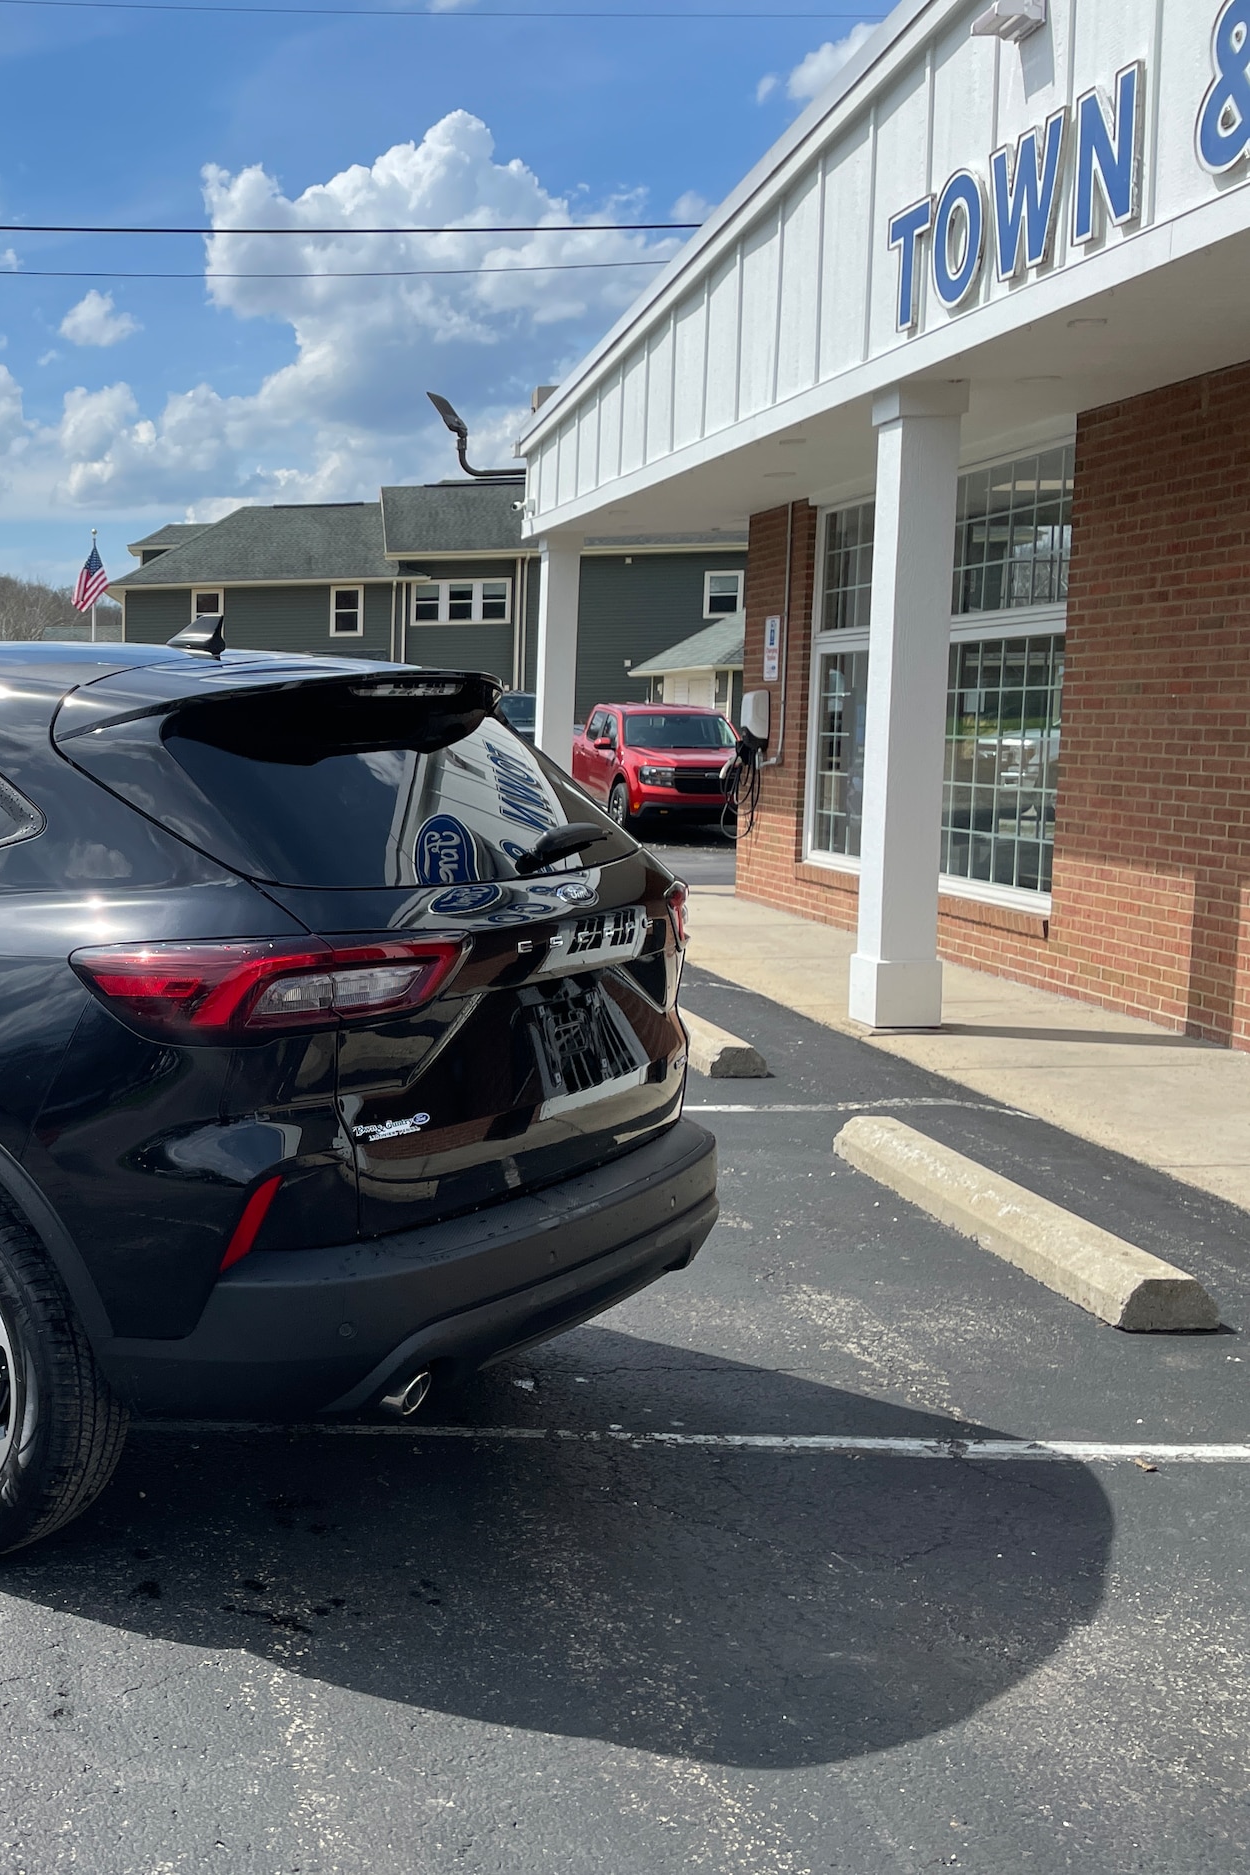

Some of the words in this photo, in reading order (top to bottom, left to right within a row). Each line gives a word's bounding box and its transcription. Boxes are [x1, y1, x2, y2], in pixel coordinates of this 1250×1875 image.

[888, 60, 1145, 333] TOWN
[1195, 0, 1250, 175] &
[562, 883, 594, 901] Ford
[517, 917, 653, 954] ESCAPE
